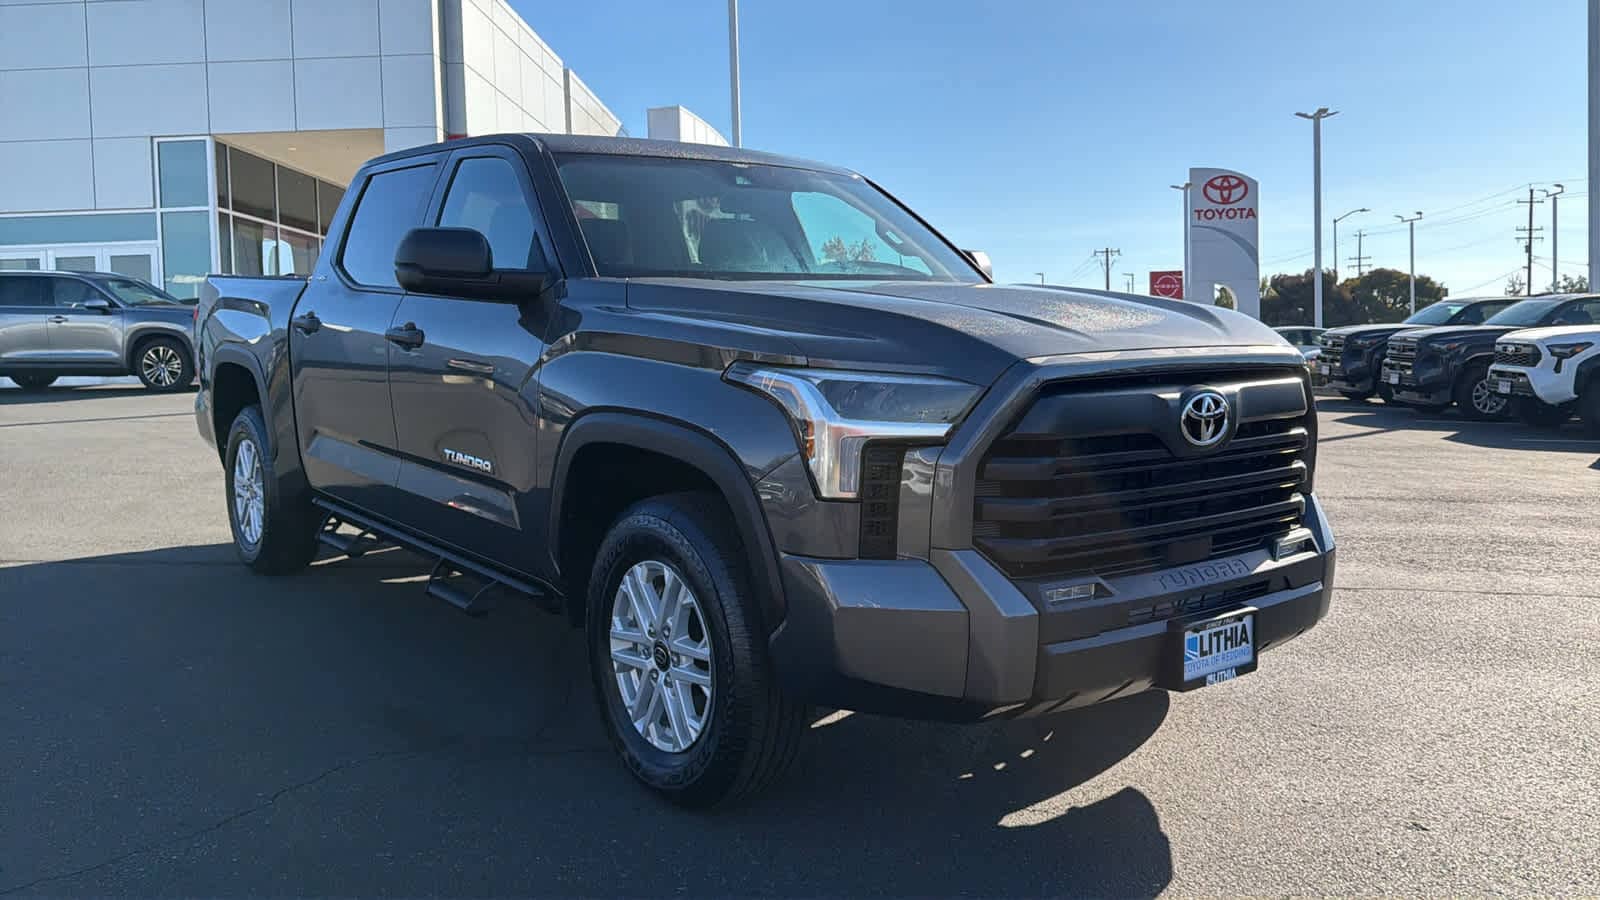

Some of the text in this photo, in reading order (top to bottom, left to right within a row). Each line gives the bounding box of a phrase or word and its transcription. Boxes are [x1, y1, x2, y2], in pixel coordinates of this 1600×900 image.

[1194, 208, 1256, 220] TOYOTA
[443, 448, 492, 473] TUNDRA
[1152, 558, 1250, 591] TUNDRA
[1200, 623, 1250, 658] LITHIA
[1211, 655, 1219, 666] OF
